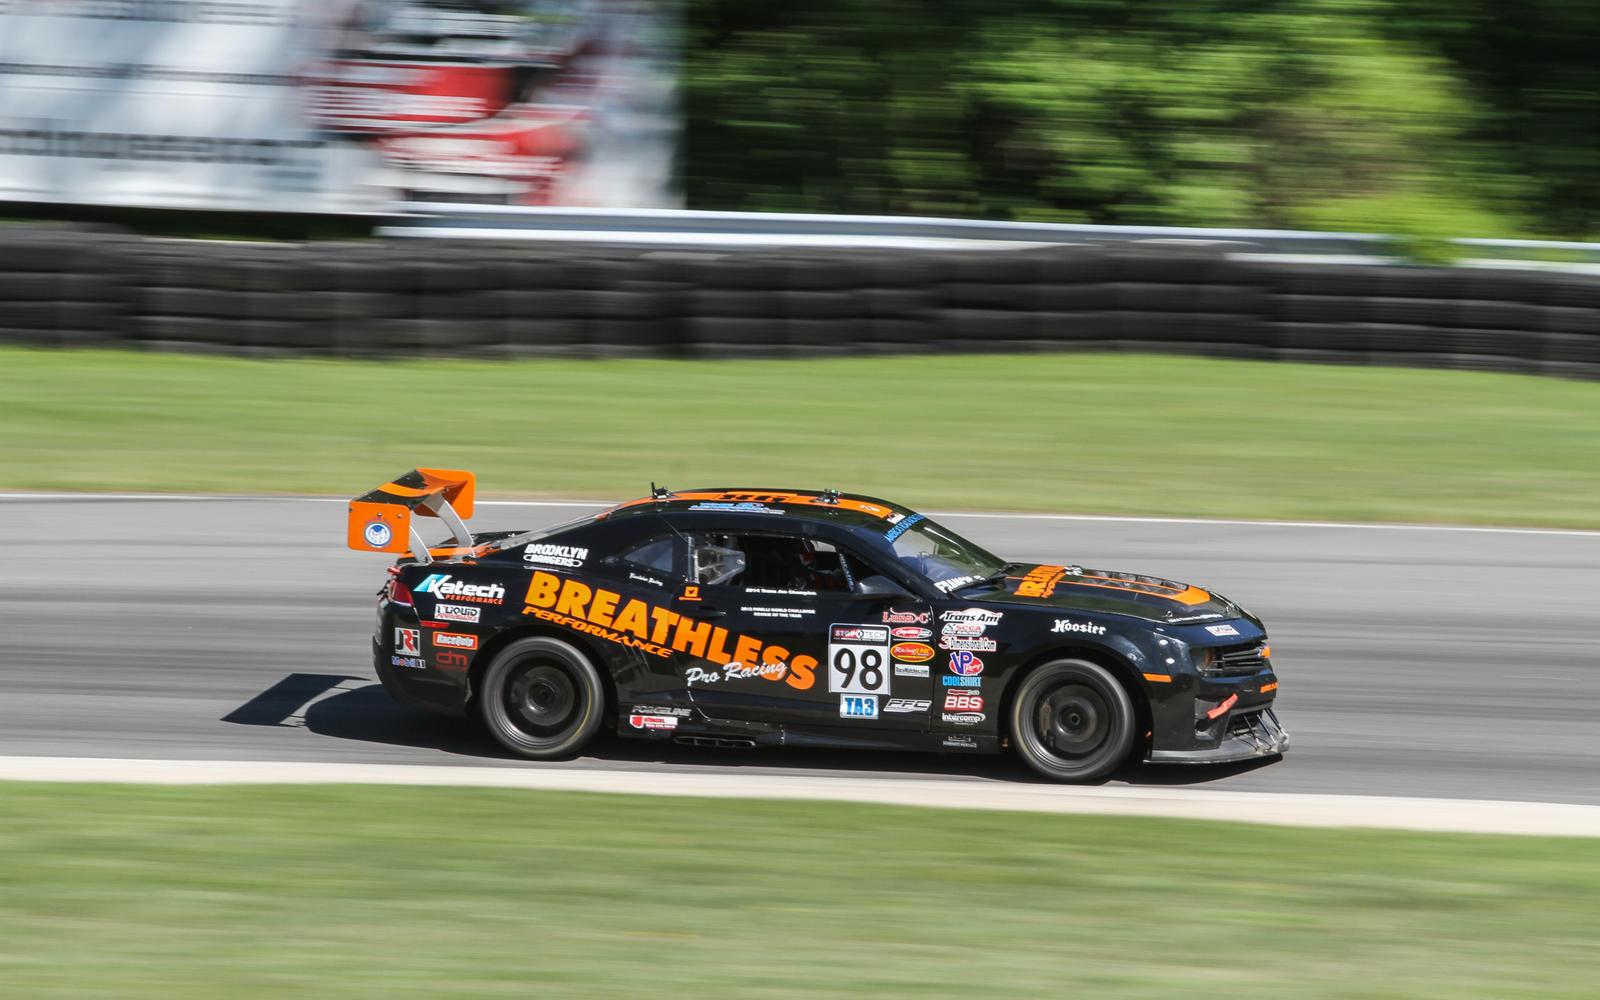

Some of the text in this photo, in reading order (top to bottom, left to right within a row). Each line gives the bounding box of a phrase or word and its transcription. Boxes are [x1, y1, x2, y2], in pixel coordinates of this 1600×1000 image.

[524, 544, 588, 560] BROOKLYN
[413, 574, 505, 600] Katech
[444, 594, 505, 605] PERFORMANCE
[944, 612, 998, 623] Trans Am
[522, 605, 674, 659] PERFORMANCE
[524, 570, 820, 690] BREATHLESS
[955, 624, 982, 632] SCCA
[1050, 619, 1106, 635] Hoosier
[833, 647, 884, 691] 98
[950, 651, 974, 675] VP
[685, 661, 788, 687] Pro Racing
[942, 676, 982, 687] COOLSHIRT
[844, 697, 875, 716] TA3
[888, 699, 931, 709] PFC
[944, 696, 983, 710] BBS
[941, 712, 981, 724] Intercomp
